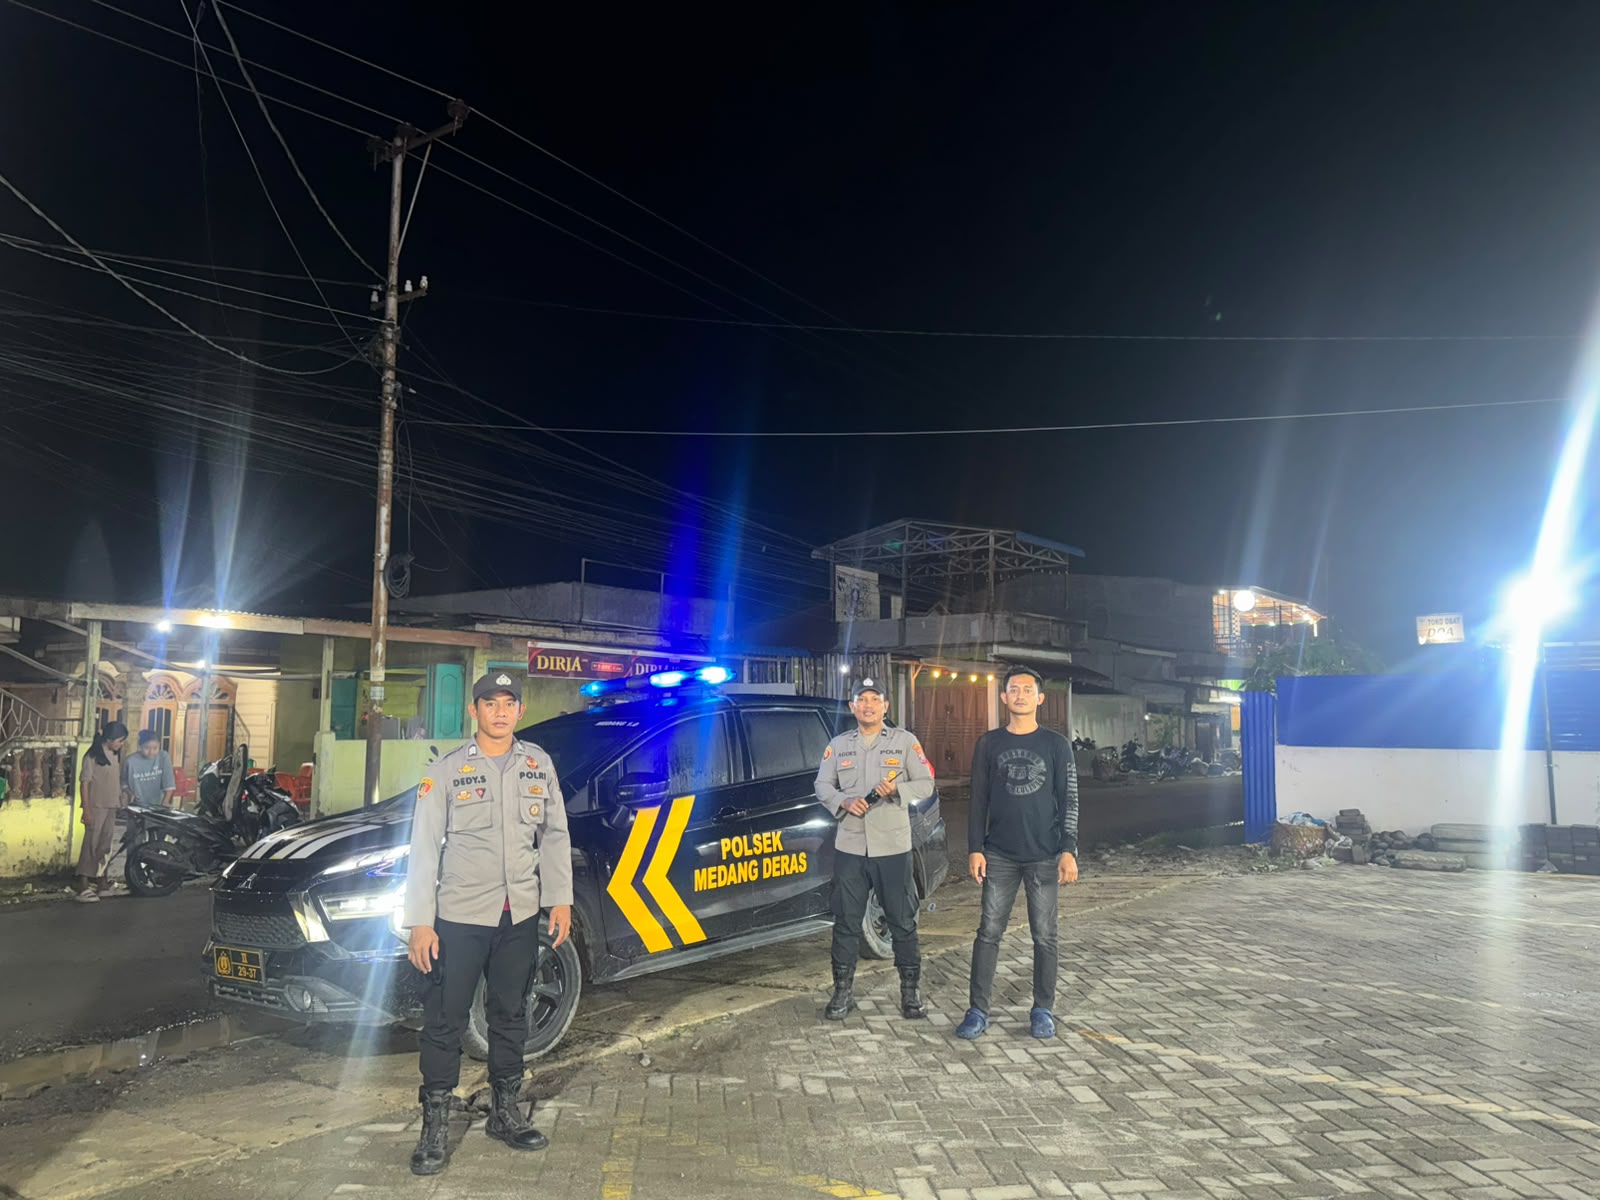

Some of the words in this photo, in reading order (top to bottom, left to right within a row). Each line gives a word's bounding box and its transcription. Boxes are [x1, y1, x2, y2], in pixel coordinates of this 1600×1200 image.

[537, 655, 582, 672] DIRJA
[453, 775, 486, 787] DEDY.S
[519, 771, 547, 780] POLRI
[720, 831, 783, 860] POLSEK
[694, 859, 759, 892] MEDANG
[762, 852, 807, 879] DERAS
[238, 966, 257, 978] 29-37
